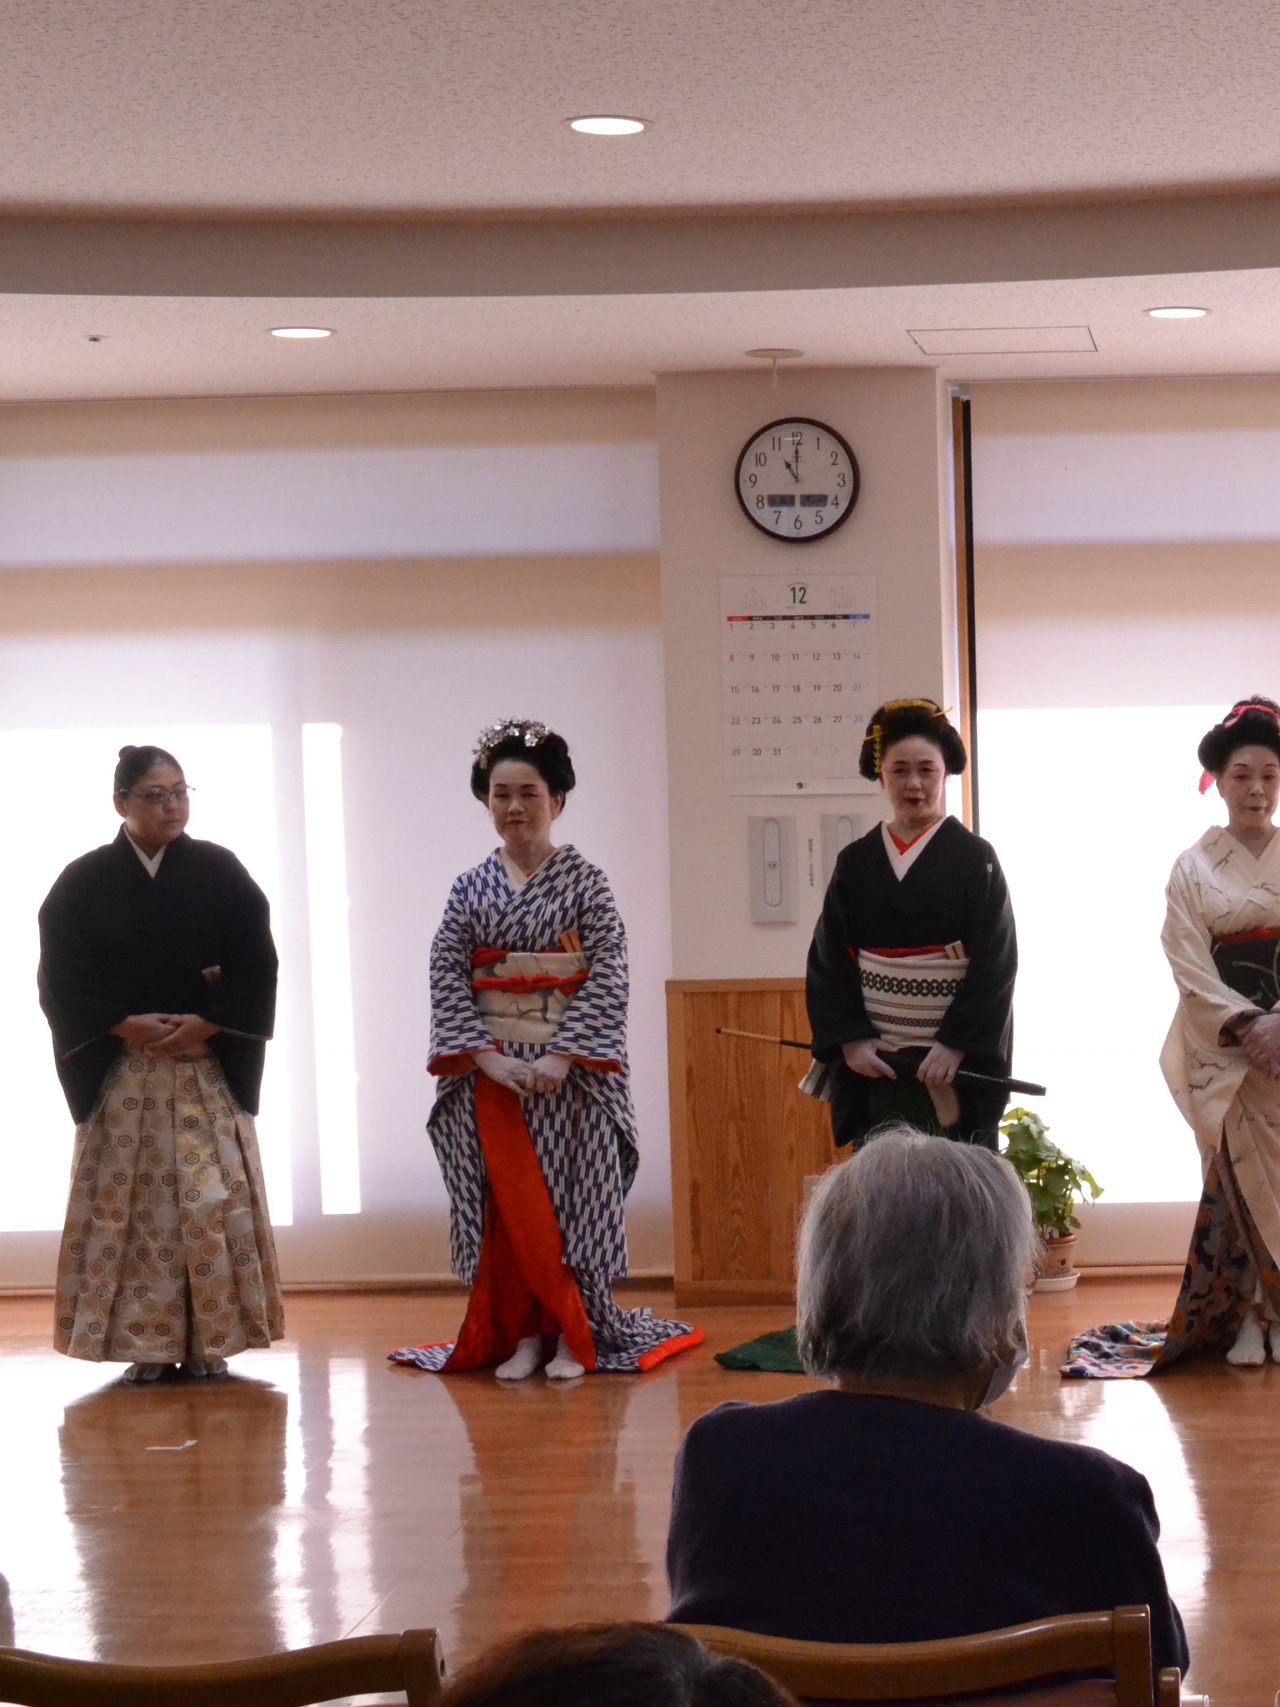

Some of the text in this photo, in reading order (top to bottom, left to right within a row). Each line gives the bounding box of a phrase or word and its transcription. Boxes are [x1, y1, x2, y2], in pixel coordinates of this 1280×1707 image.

[772, 437, 782, 450] 11
[792, 432, 803, 446] 12
[816, 437, 820, 450] 1
[755, 452, 766, 467] 10
[830, 451, 838, 466] 2
[749, 474, 758, 488] 9
[838, 473, 846, 488] 3
[756, 494, 764, 510] 8
[830, 495, 840, 508] 4
[774, 511, 782, 525] 7
[794, 515, 802, 529] 6
[814, 511, 824, 524] 5
[790, 586, 807, 604] 12
[832, 621, 836, 629] 6
[833, 684, 842, 692] 20
[772, 748, 781, 756] 31
